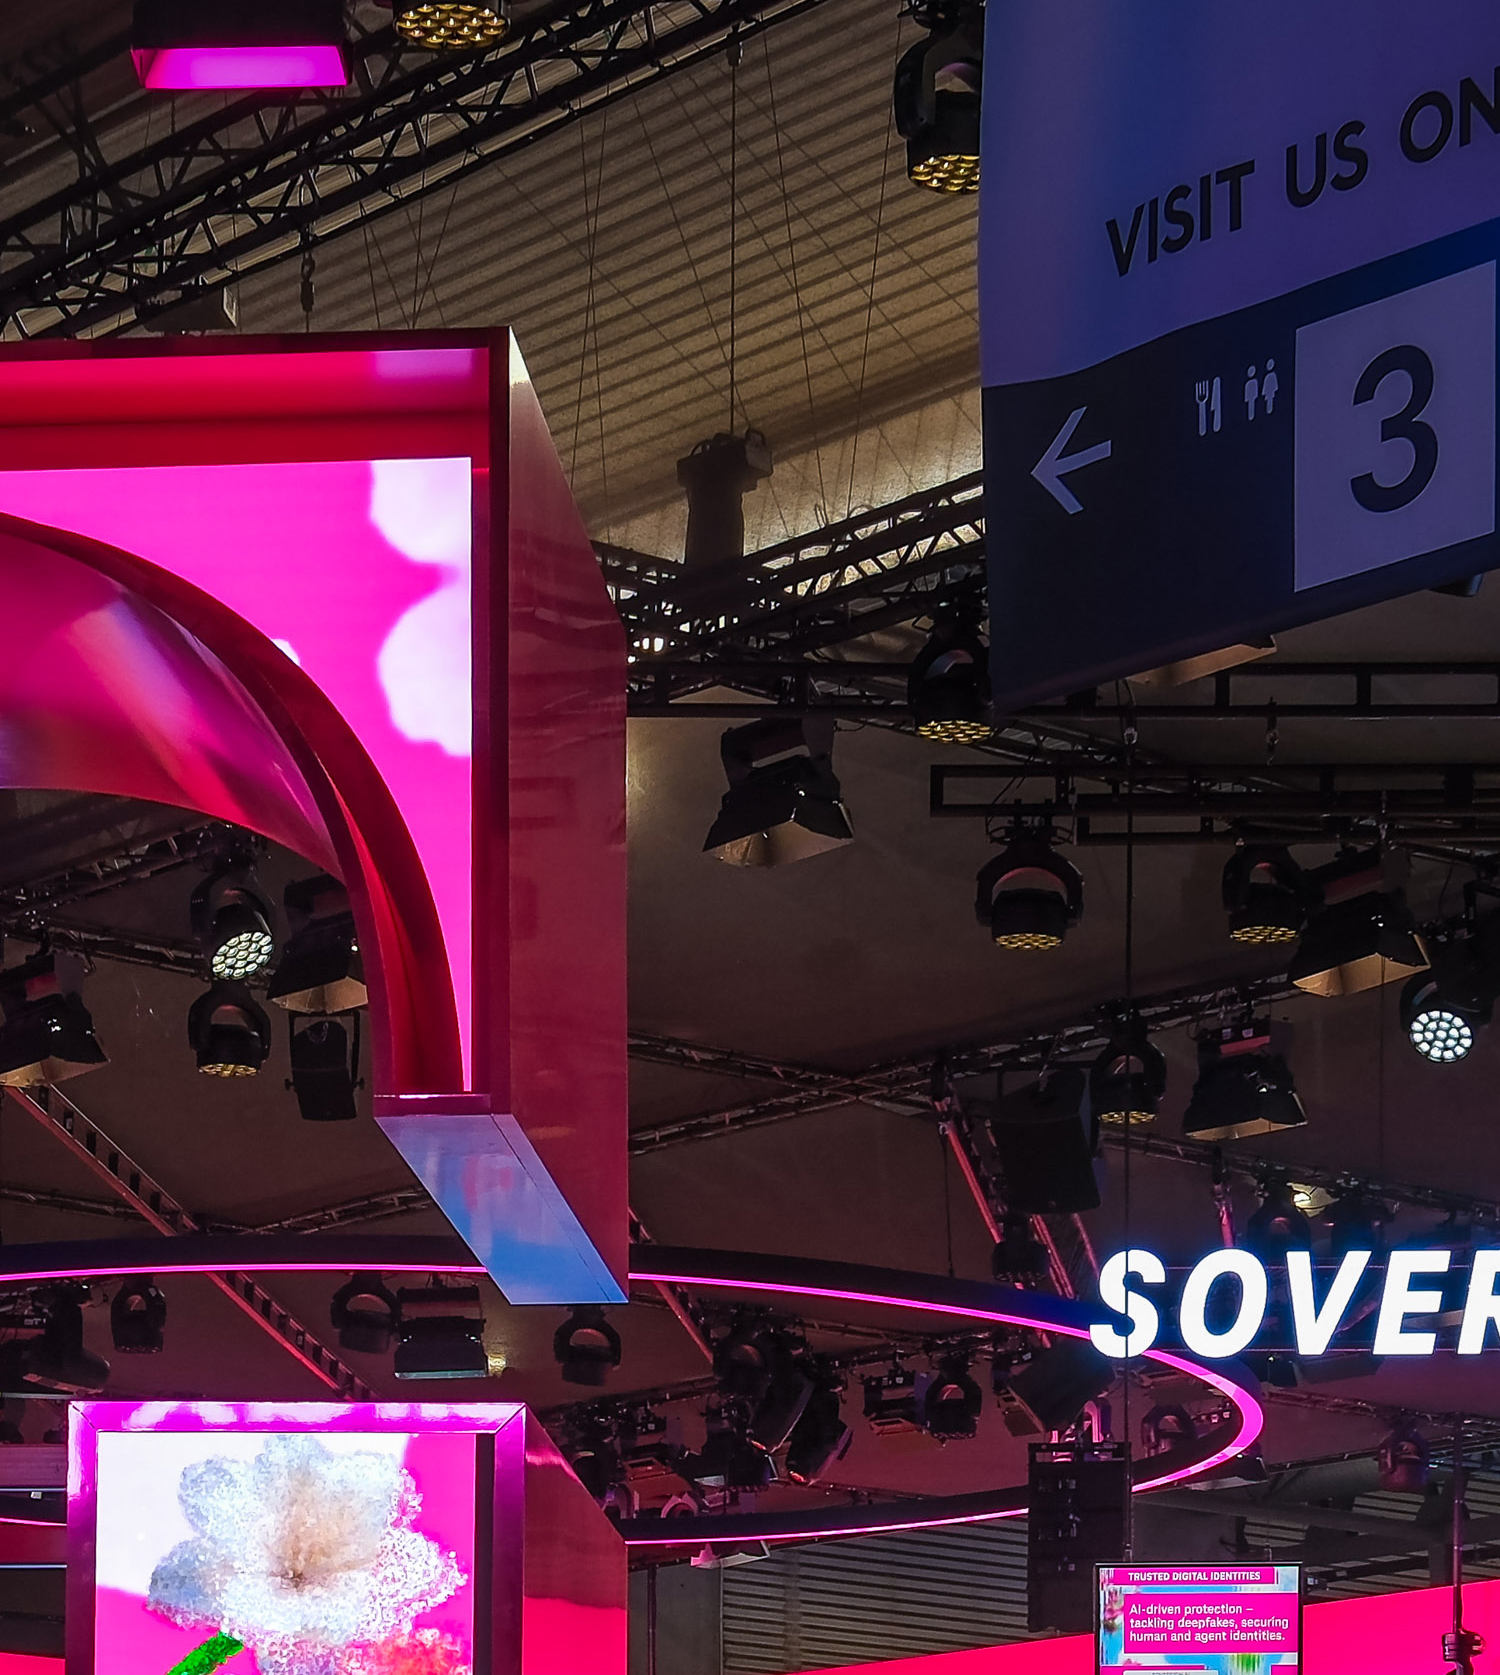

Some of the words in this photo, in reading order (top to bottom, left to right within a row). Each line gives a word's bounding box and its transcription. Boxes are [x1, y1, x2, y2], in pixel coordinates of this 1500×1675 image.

[1105, 161, 1255, 277] VISIT
[1285, 121, 1369, 207] US
[1349, 344, 1440, 513] 3
[1128, 1572, 1170, 1582] TRUSTED
[1172, 1572, 1208, 1581] DIGITAL
[1210, 1571, 1261, 1581] IDENTITIES
[1129, 1604, 1182, 1615] AI-driven
[1184, 1604, 1242, 1617] protection
[1130, 1617, 1174, 1630] tackling
[1178, 1617, 1238, 1630] deepfakes,
[1241, 1616, 1289, 1630] securing
[1130, 1631, 1168, 1642] human
[1170, 1630, 1192, 1642] and
[1194, 1632, 1227, 1644] agent
[1229, 1630, 1286, 1642] identities.
